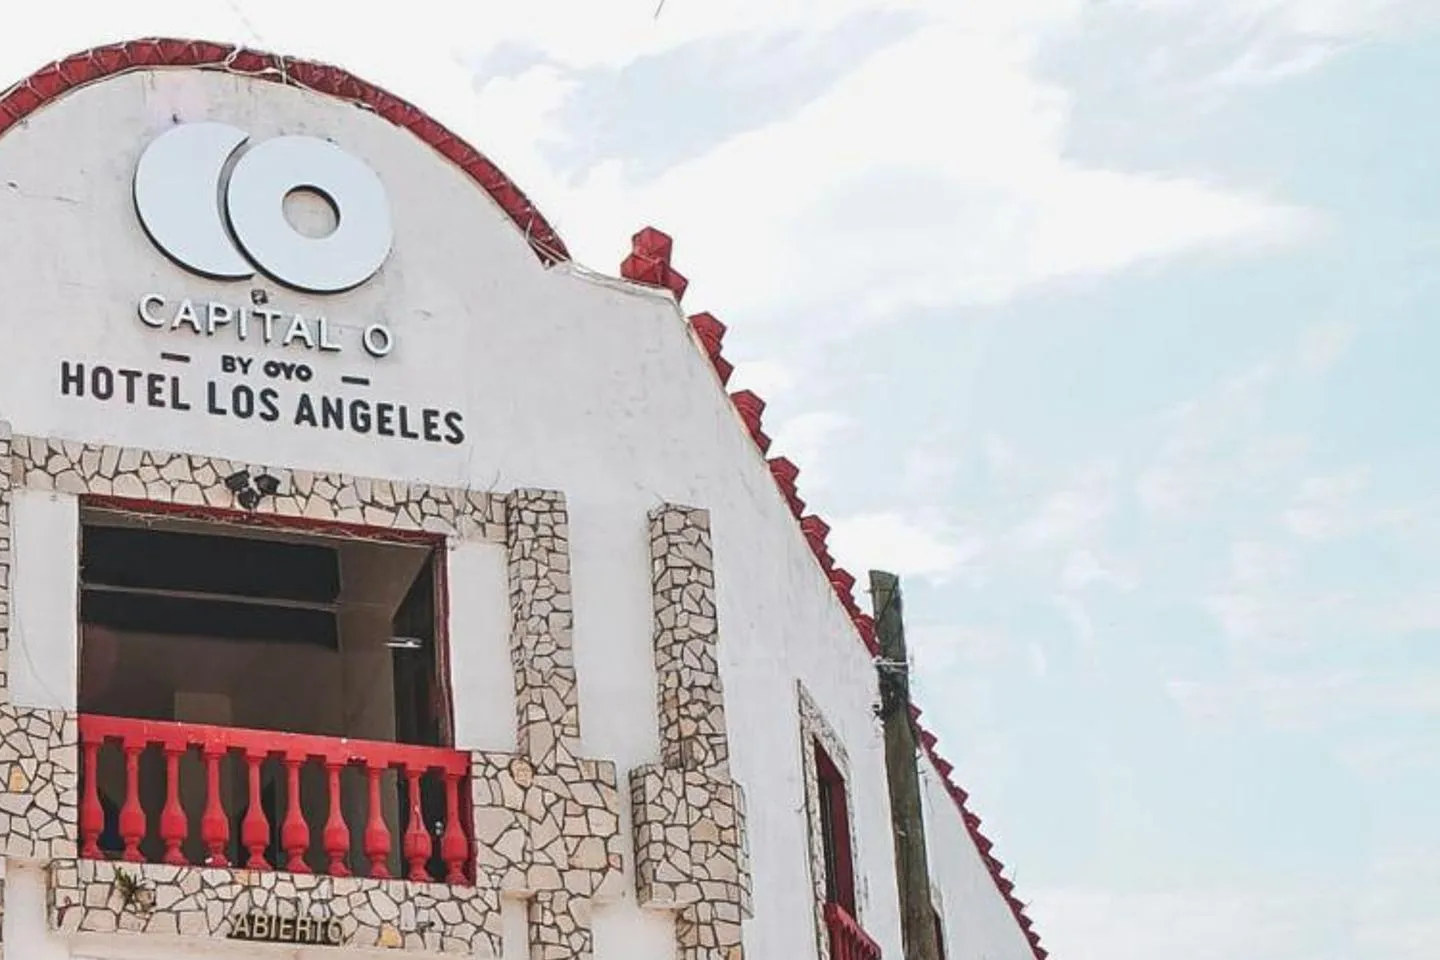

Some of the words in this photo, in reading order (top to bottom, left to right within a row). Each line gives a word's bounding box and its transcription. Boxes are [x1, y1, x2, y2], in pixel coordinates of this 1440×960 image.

[138, 293, 343, 352] CAPITAL
[363, 322, 394, 358] O
[221, 354, 253, 375] BY
[263, 360, 313, 382] OYO
[61, 361, 191, 411] HOTEL
[207, 381, 280, 422] LOS
[294, 392, 465, 445] ANGELES
[231, 911, 345, 946] ABIERTO
